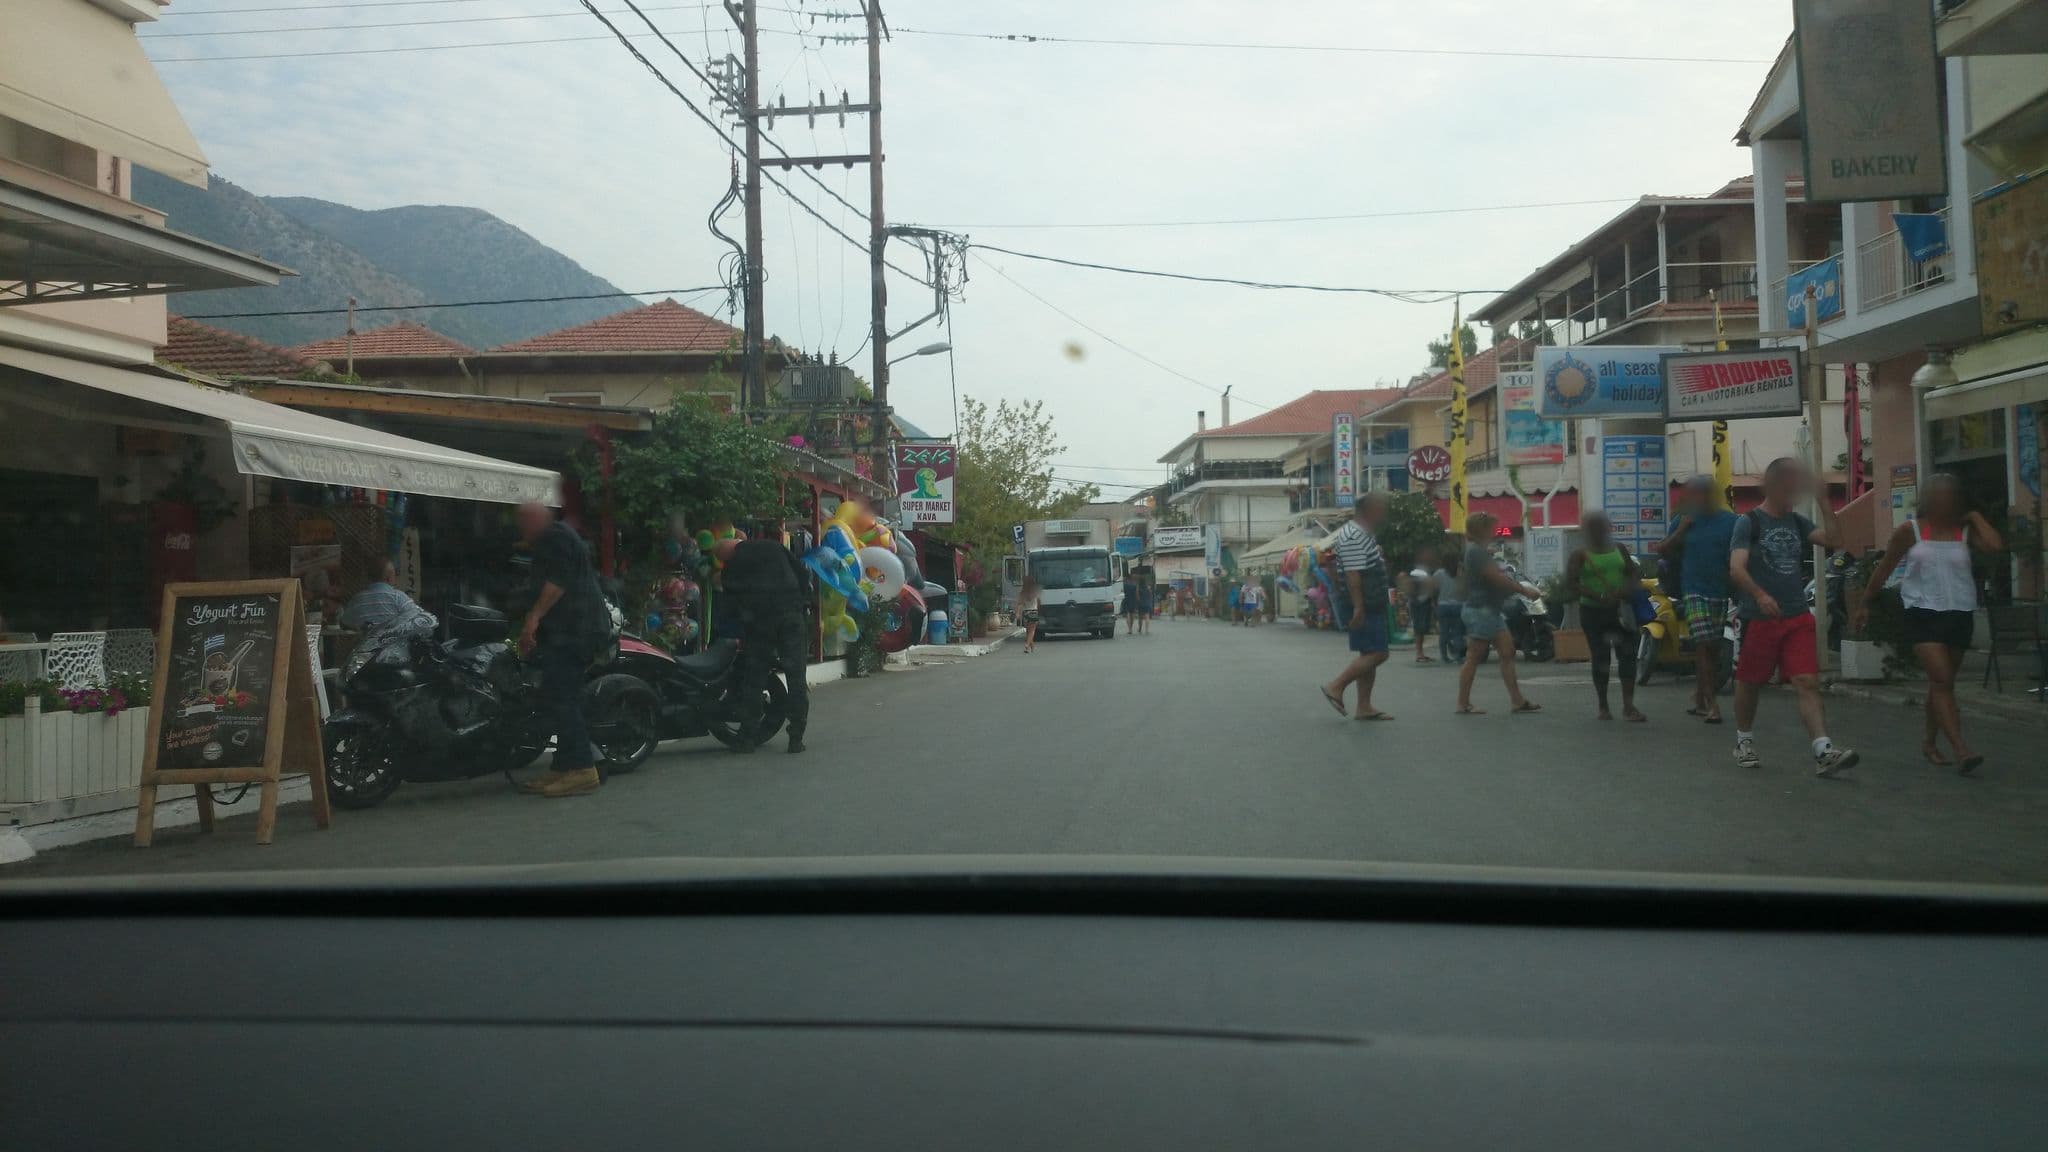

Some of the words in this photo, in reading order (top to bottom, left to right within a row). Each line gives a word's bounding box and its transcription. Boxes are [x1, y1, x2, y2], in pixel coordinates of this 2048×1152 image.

[1831, 155, 1919, 178] BAKERY
[1600, 360, 1617, 377] all
[1702, 359, 1793, 389] BROUMIS
[1612, 384, 1663, 405] holiday
[1682, 394, 1698, 407] CAR
[1707, 385, 1756, 401] MOTORBIKE
[1757, 376, 1794, 393] RENTALS
[288, 453, 333, 474] FROZEN
[335, 457, 377, 478] YOGURT
[902, 501, 923, 512] SUPER
[925, 501, 952, 512] MARKET
[917, 513, 937, 521] KAVA
[1013, 525, 1024, 539] P
[186, 603, 238, 626] Yogurt
[240, 602, 266, 619] Fun
